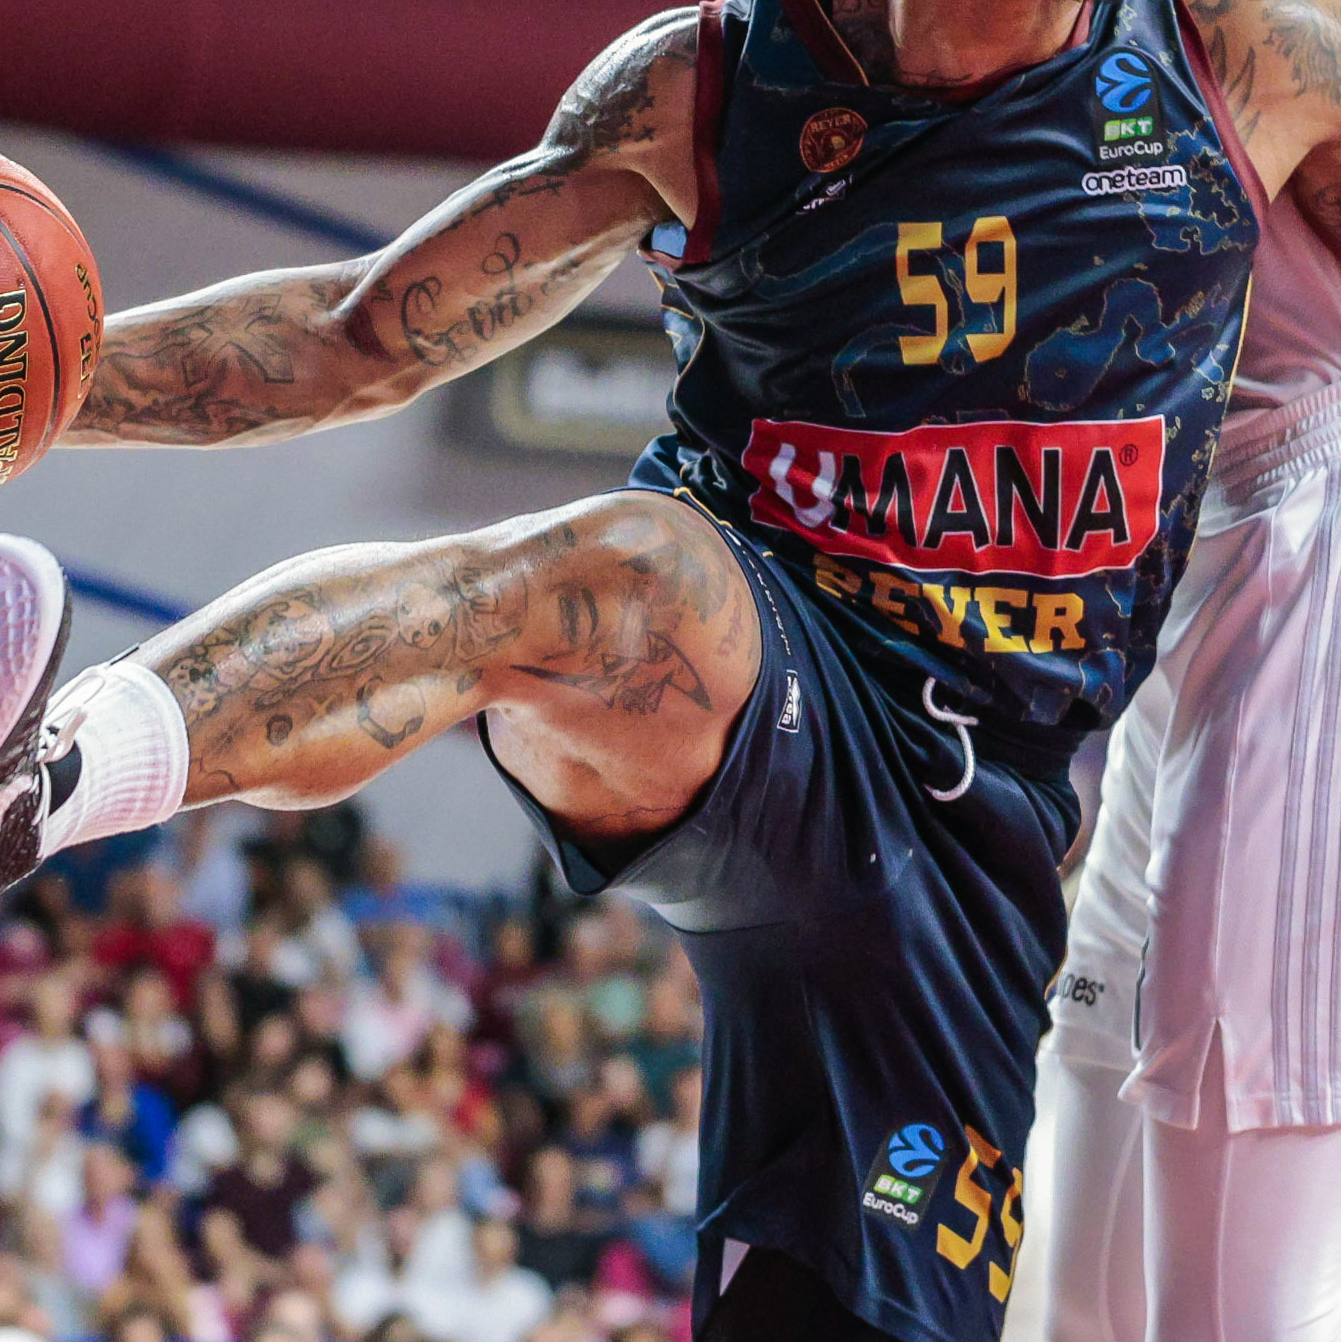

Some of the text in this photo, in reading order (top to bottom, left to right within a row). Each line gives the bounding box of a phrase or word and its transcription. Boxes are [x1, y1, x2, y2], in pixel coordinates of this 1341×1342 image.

[1099, 141, 1164, 160] EuroCup
[1084, 166, 1185, 193] oneteam
[896, 216, 1017, 365] 59
[768, 442, 1131, 552] UMANA
[813, 554, 1087, 654] REYER
[875, 1175, 924, 1204] BKT
[862, 1192, 919, 1225] EuroCup
